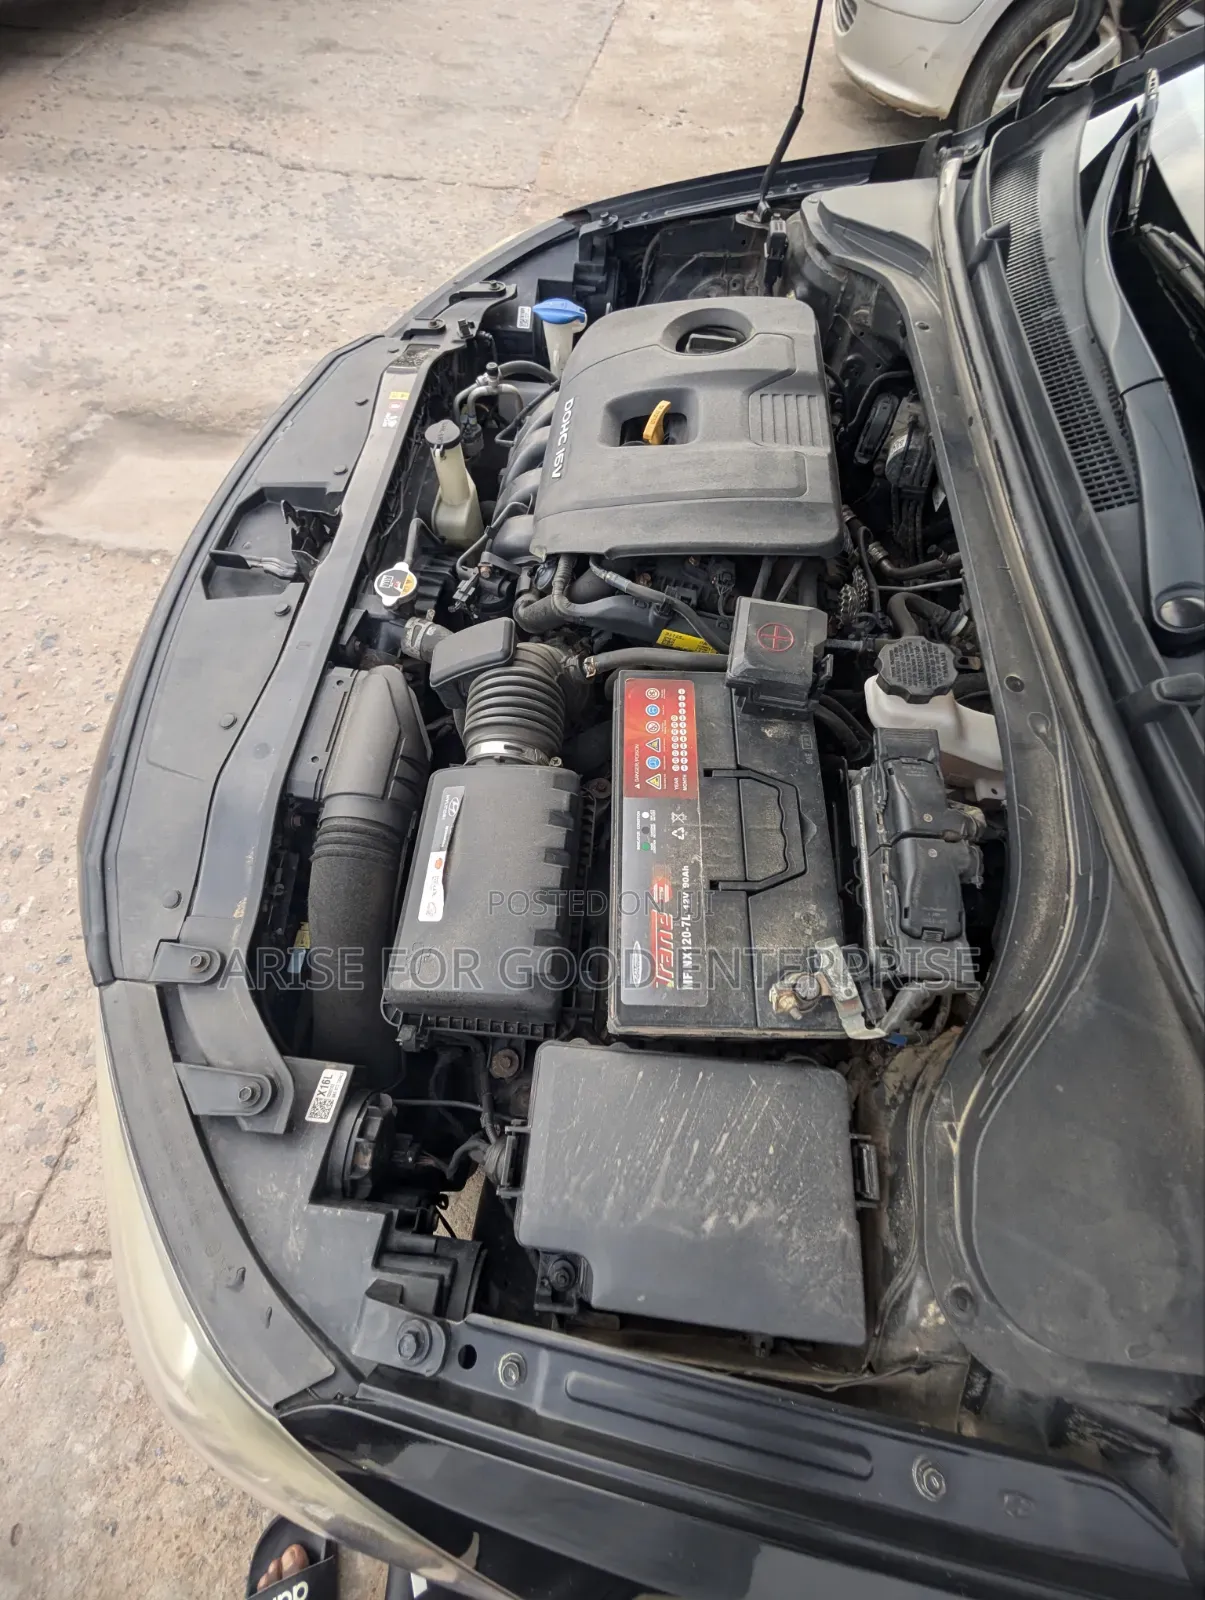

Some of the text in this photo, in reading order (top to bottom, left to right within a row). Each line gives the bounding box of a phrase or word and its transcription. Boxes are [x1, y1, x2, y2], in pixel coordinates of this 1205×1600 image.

[552, 396, 575, 478] DOHC 16V
[681, 865, 690, 888] 90Ah
[681, 914, 693, 968] NX120-7L
[317, 1074, 333, 1097] X16L
